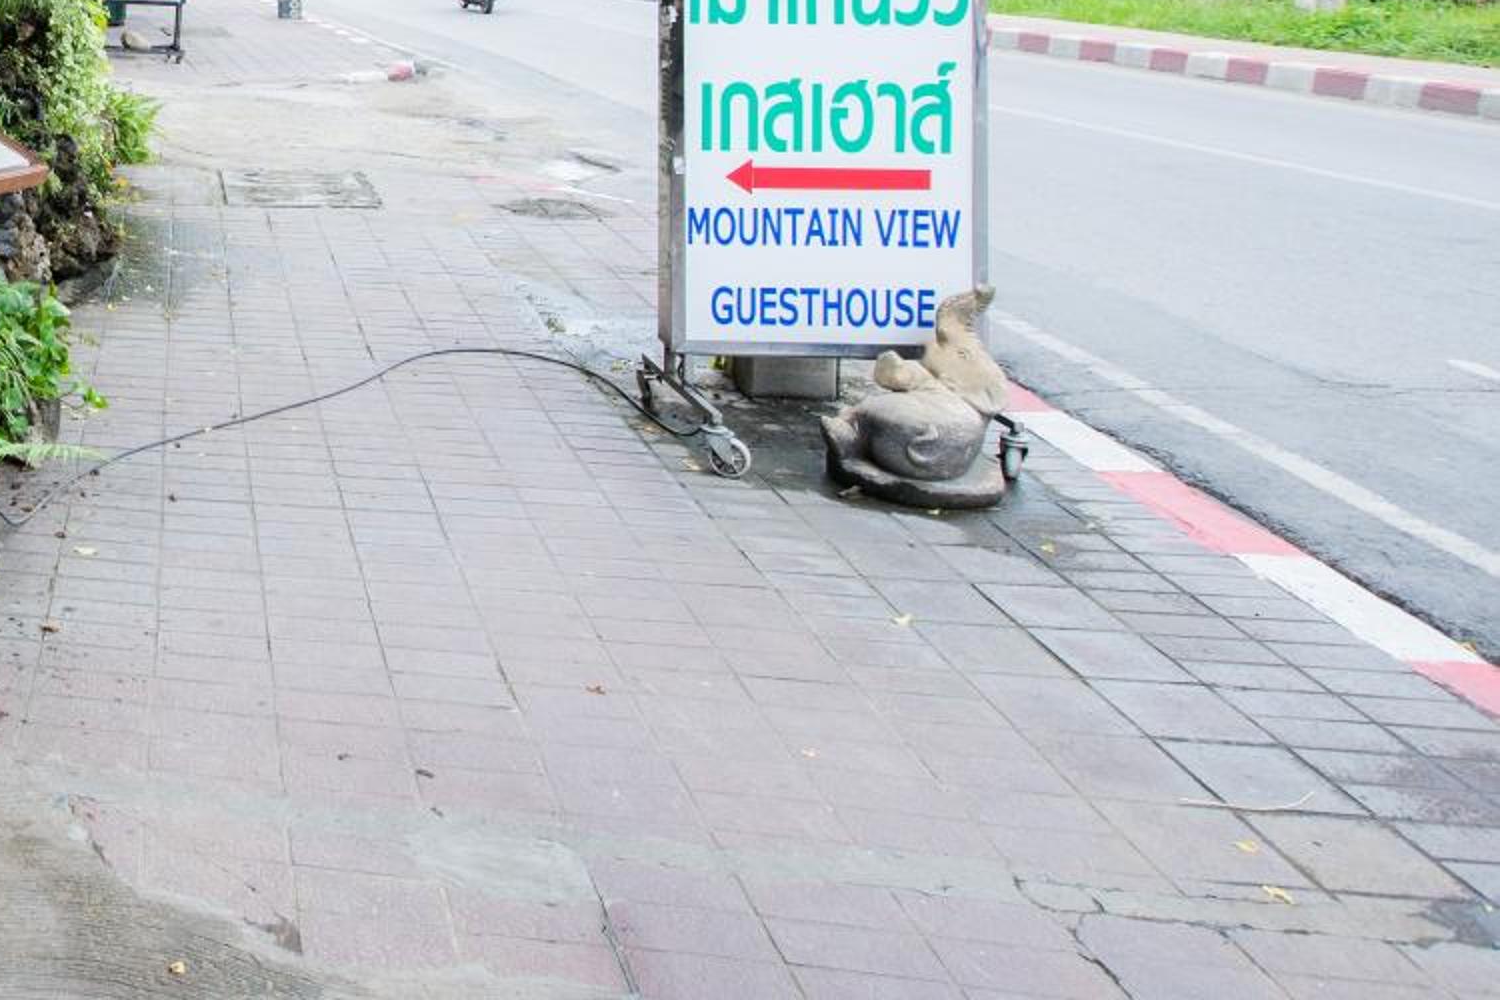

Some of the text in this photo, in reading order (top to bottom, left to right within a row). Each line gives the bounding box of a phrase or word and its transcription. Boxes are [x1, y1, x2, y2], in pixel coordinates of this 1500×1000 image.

[701, 62, 957, 154] เกสเฮาส์
[687, 207, 962, 249] MOUNTAIN VIEW
[711, 285, 936, 329] GUESTHOUSE
